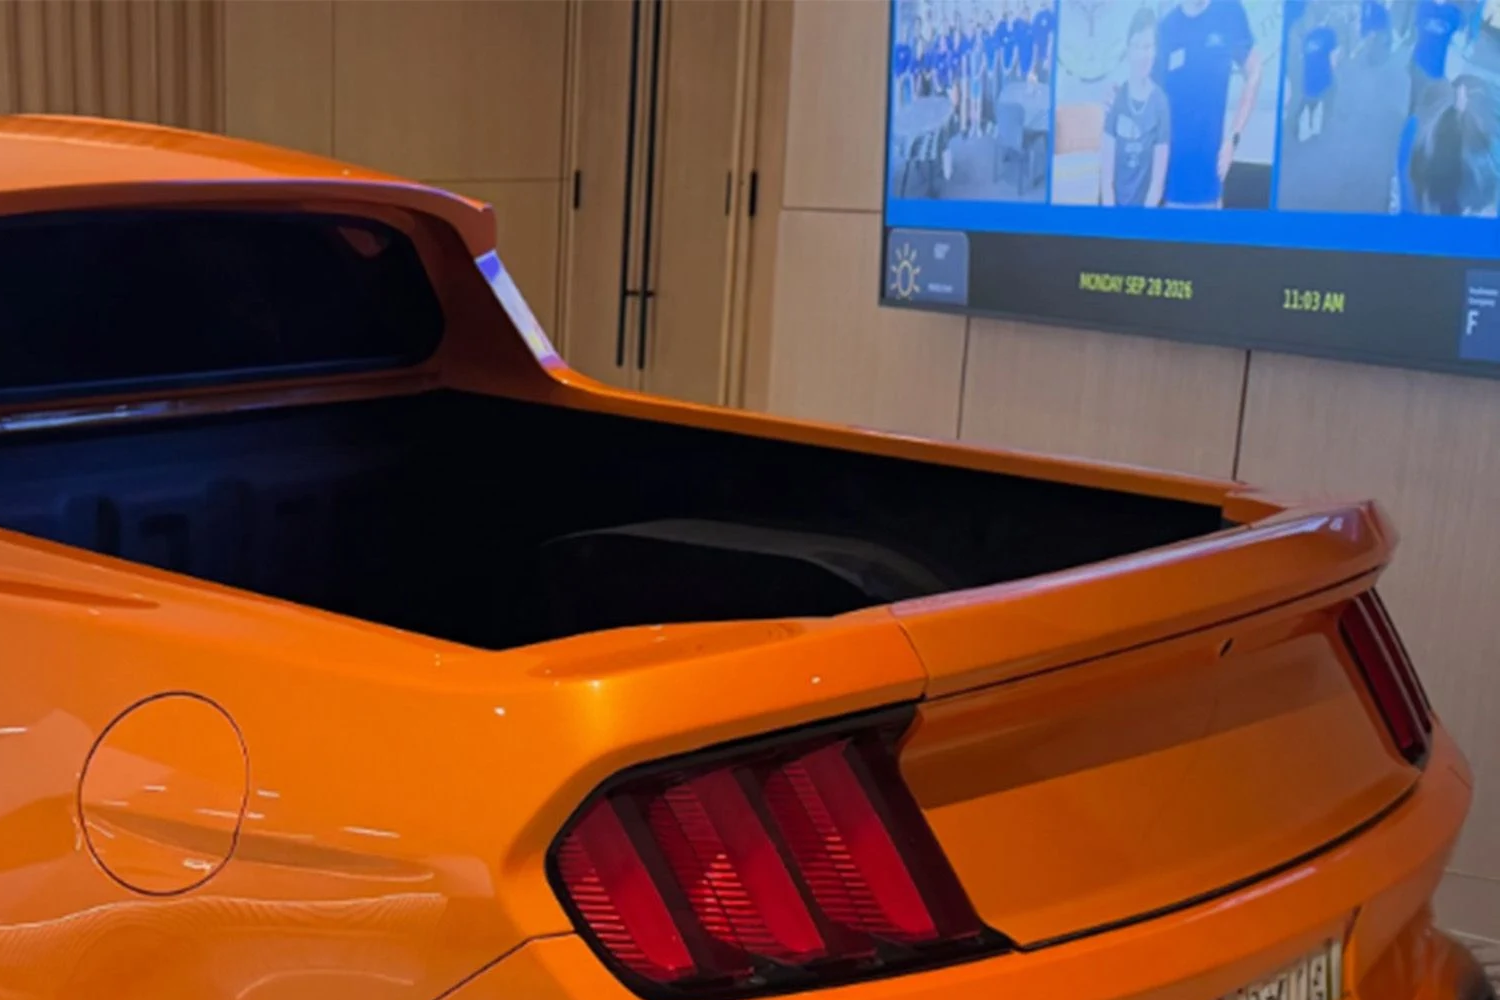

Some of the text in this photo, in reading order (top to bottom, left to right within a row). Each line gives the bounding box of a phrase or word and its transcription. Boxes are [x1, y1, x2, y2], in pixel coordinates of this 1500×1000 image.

[1079, 271, 1123, 292] MONDAY
[1125, 275, 1146, 295] SEP
[1283, 287, 1345, 314] 11:03 AM
